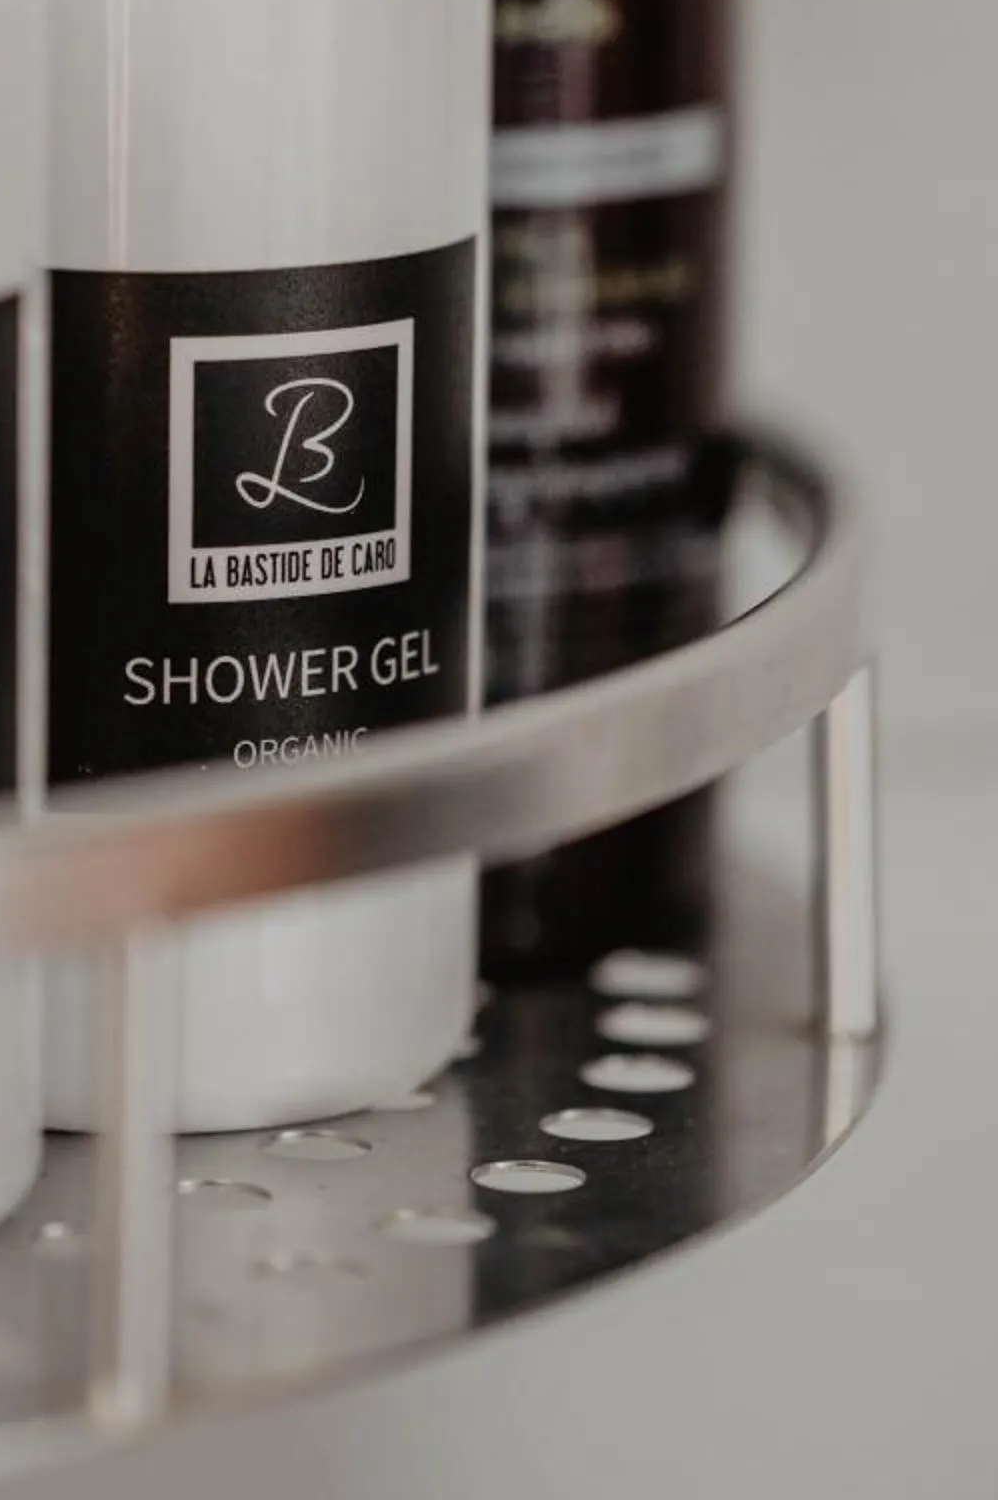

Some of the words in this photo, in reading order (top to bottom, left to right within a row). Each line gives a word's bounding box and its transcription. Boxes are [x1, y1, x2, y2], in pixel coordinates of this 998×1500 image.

[189, 555, 217, 589] LA
[226, 549, 313, 588] BASTIDE
[321, 545, 345, 580] DE
[352, 537, 396, 577] CARO
[122, 644, 360, 706] SHOWER
[370, 628, 440, 686] GEL
